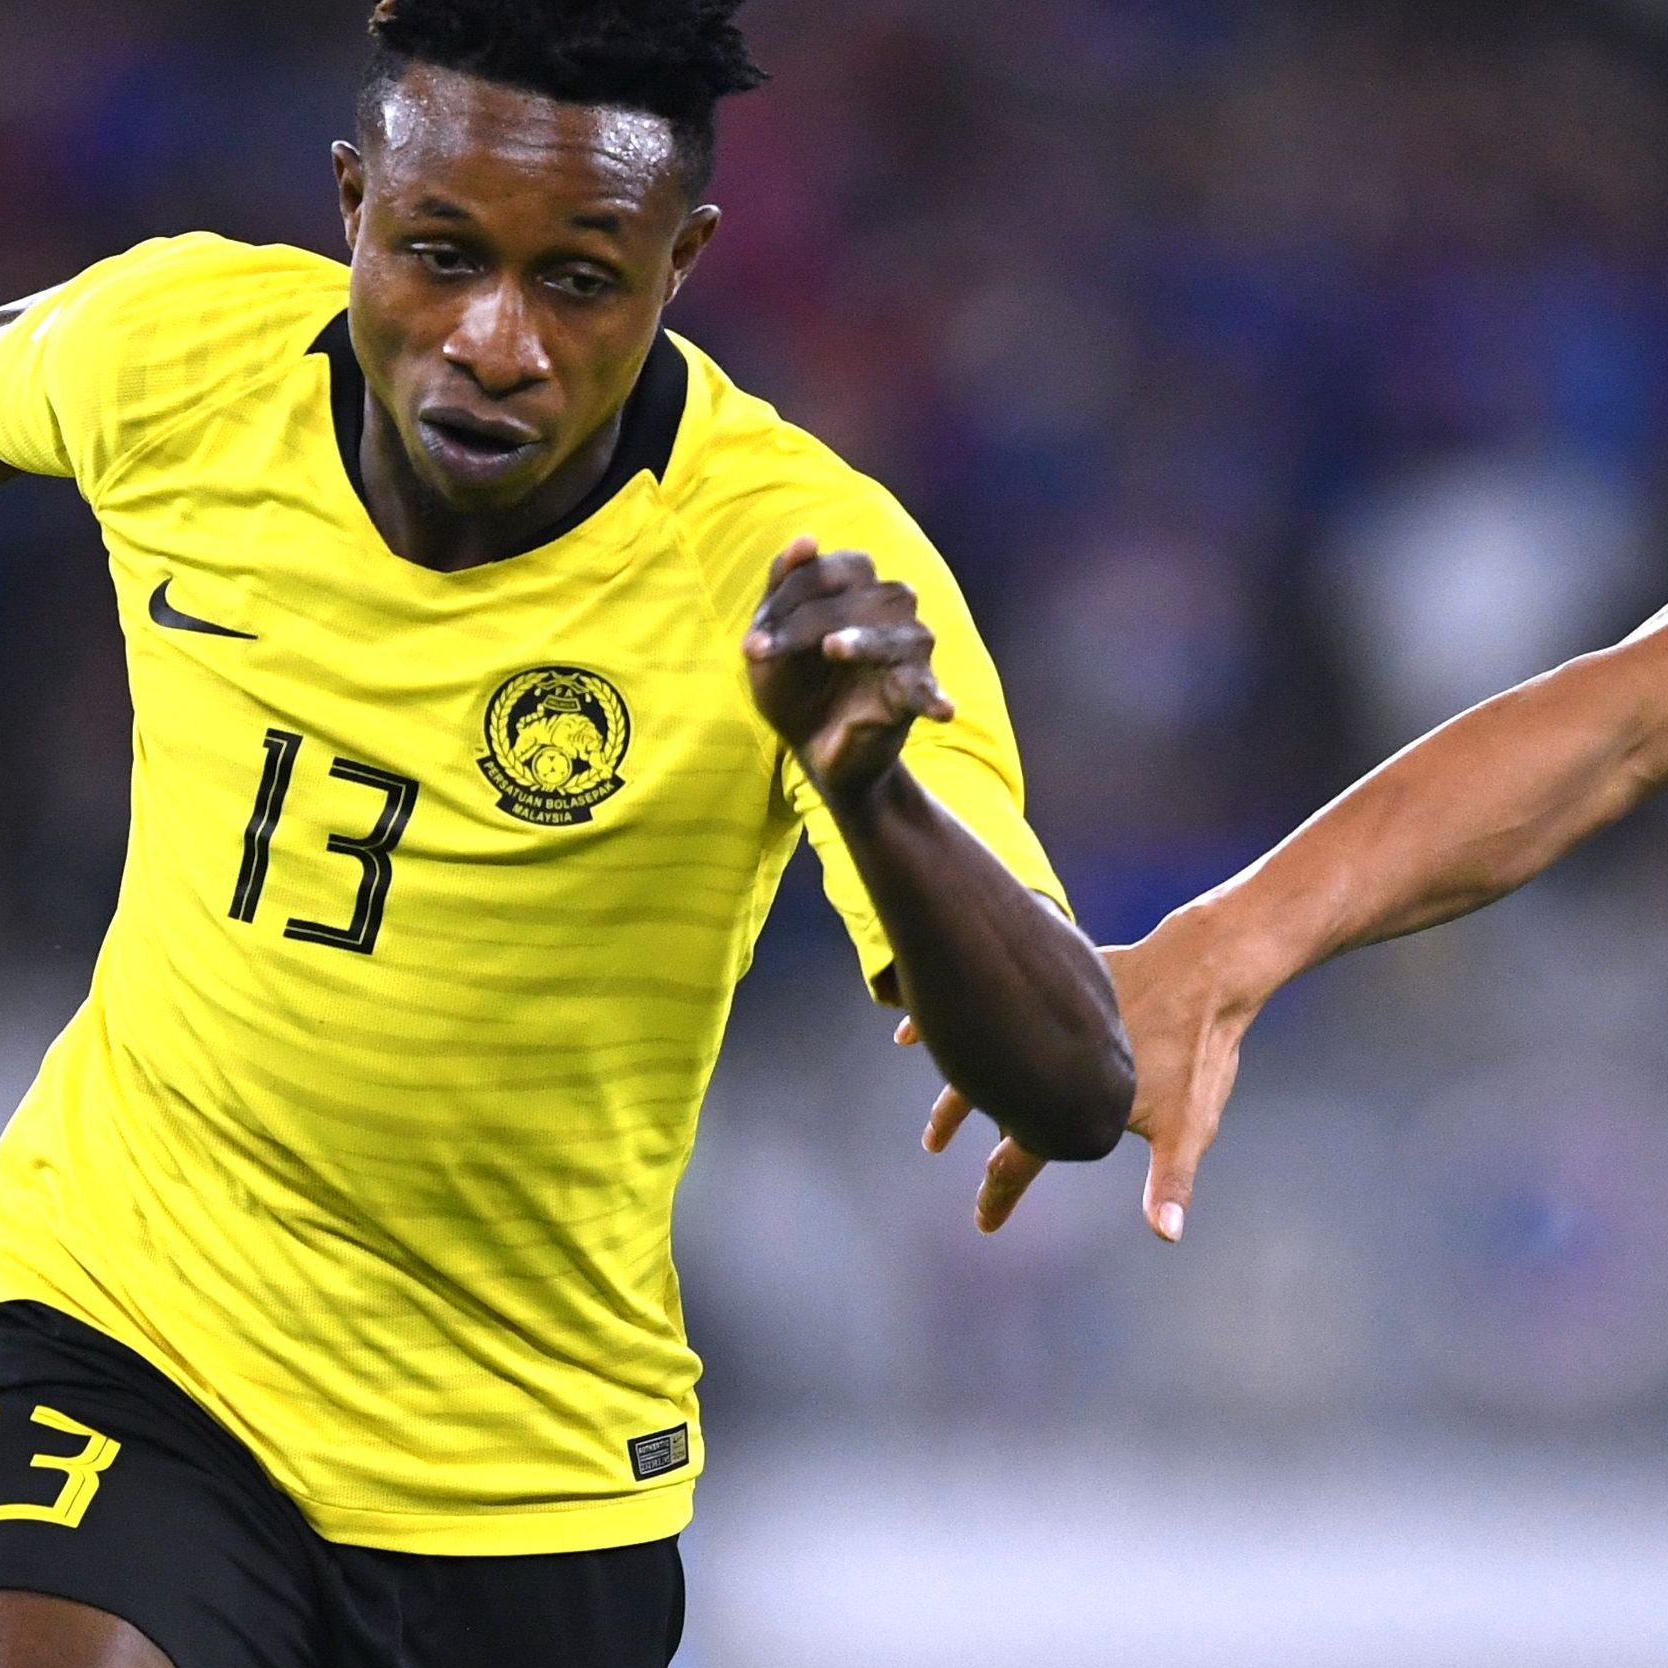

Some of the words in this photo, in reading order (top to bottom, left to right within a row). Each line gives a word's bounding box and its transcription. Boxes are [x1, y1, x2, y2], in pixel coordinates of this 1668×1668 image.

[484, 761, 543, 807] PERSATUAN
[545, 781, 615, 811] BOLASEPAK
[511, 804, 573, 823] MALAYSIA
[228, 727, 420, 955] 13
